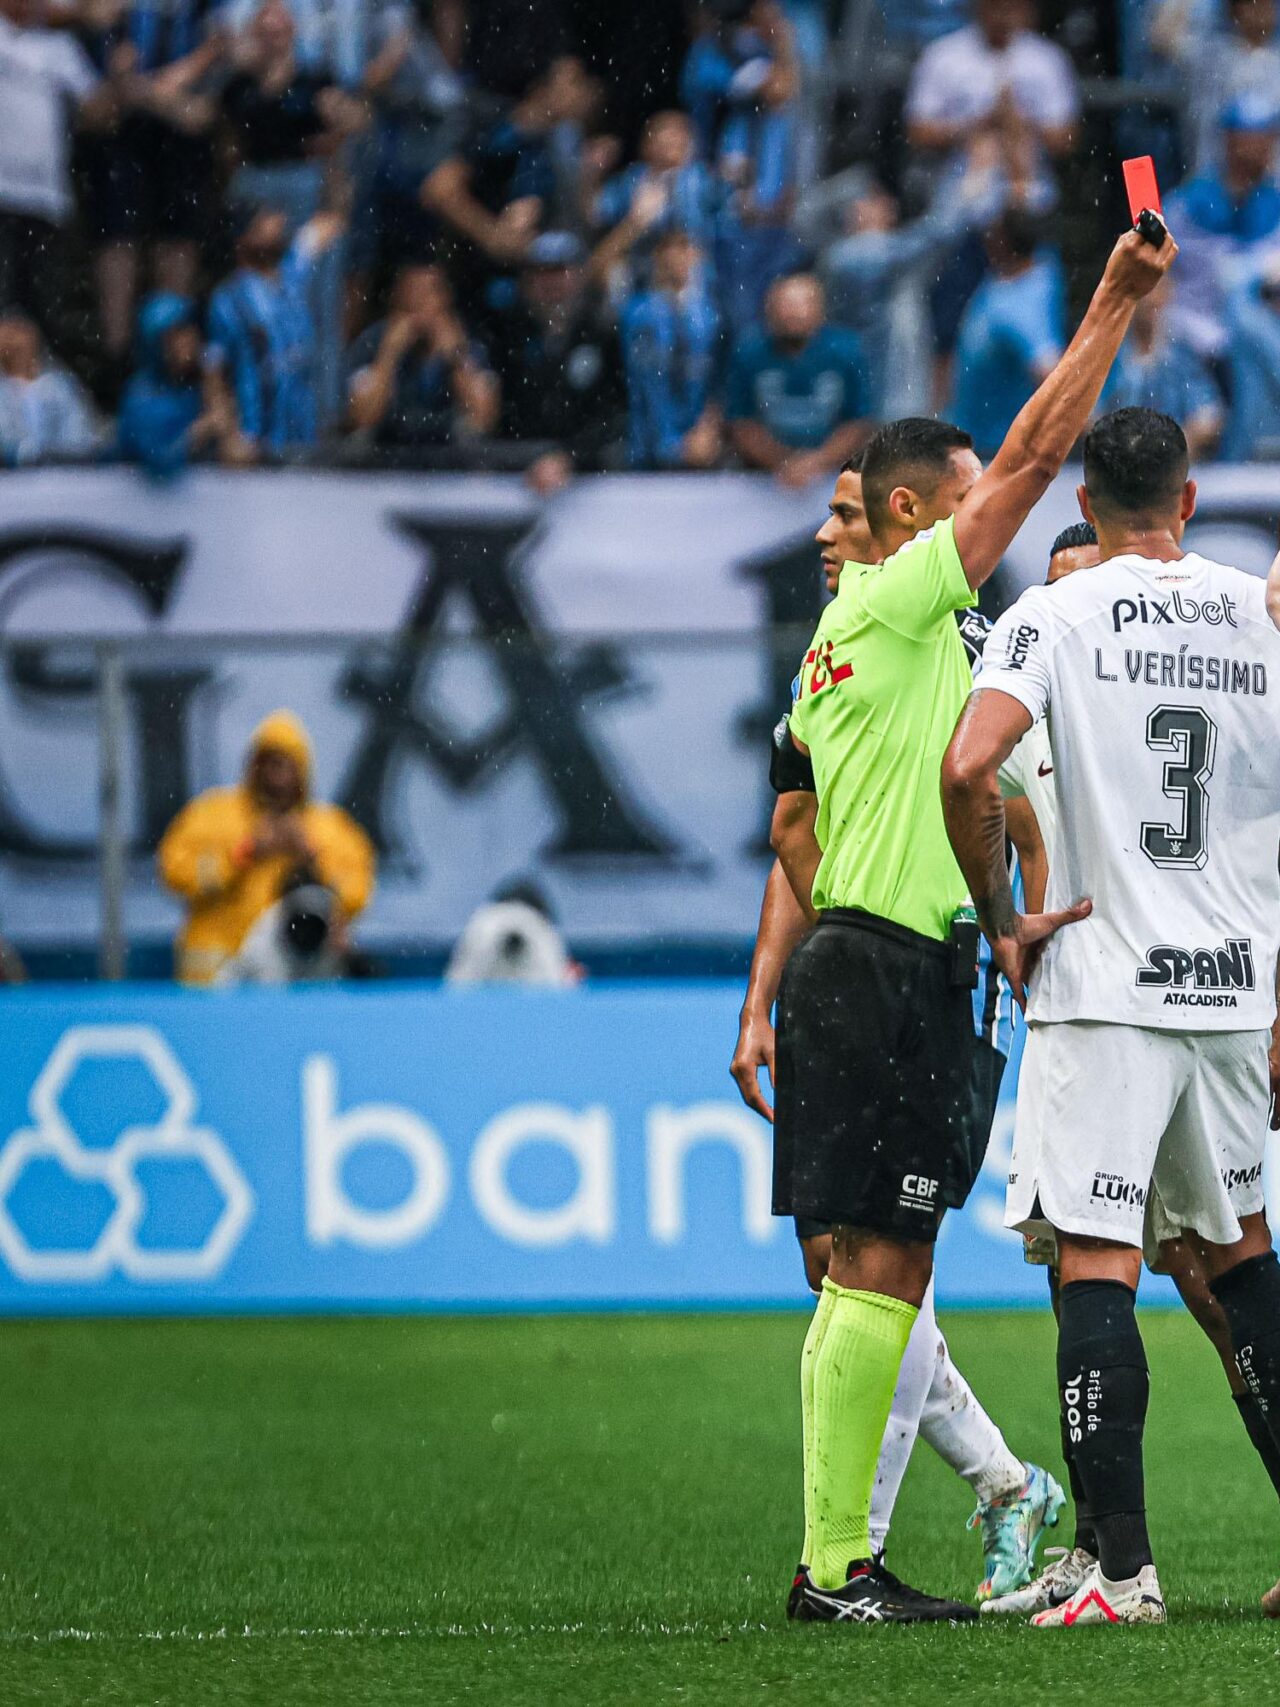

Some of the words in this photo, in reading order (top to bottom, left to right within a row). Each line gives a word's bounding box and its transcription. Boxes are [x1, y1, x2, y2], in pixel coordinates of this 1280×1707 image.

[1111, 590, 1238, 633] pixbet
[1094, 647, 1119, 682] L.
[1124, 643, 1268, 697] VERÍSSIMO
[1139, 703, 1219, 872] 3
[1163, 992, 1238, 1008] ATACADISTA
[902, 1173, 939, 1199] CBF
[1094, 1171, 1124, 1183] GRUPO
[1257, 1396, 1269, 1412] de
[1087, 1413, 1102, 1432] de
